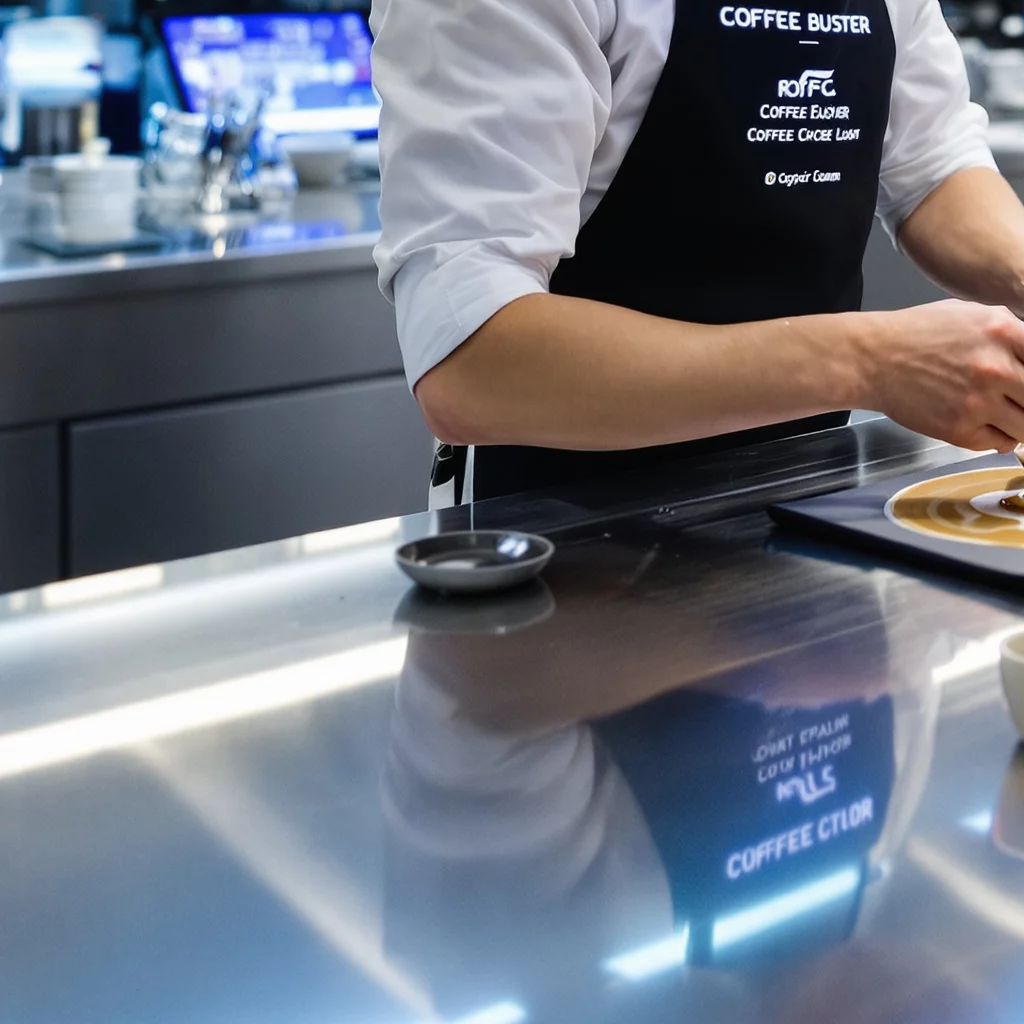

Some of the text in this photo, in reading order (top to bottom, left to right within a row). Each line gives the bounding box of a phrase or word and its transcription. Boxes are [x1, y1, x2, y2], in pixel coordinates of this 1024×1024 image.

[719, 6, 872, 34] COFFEE BUSTER
[760, 104, 808, 120] COFFEE
[747, 127, 795, 142] COFFEE
